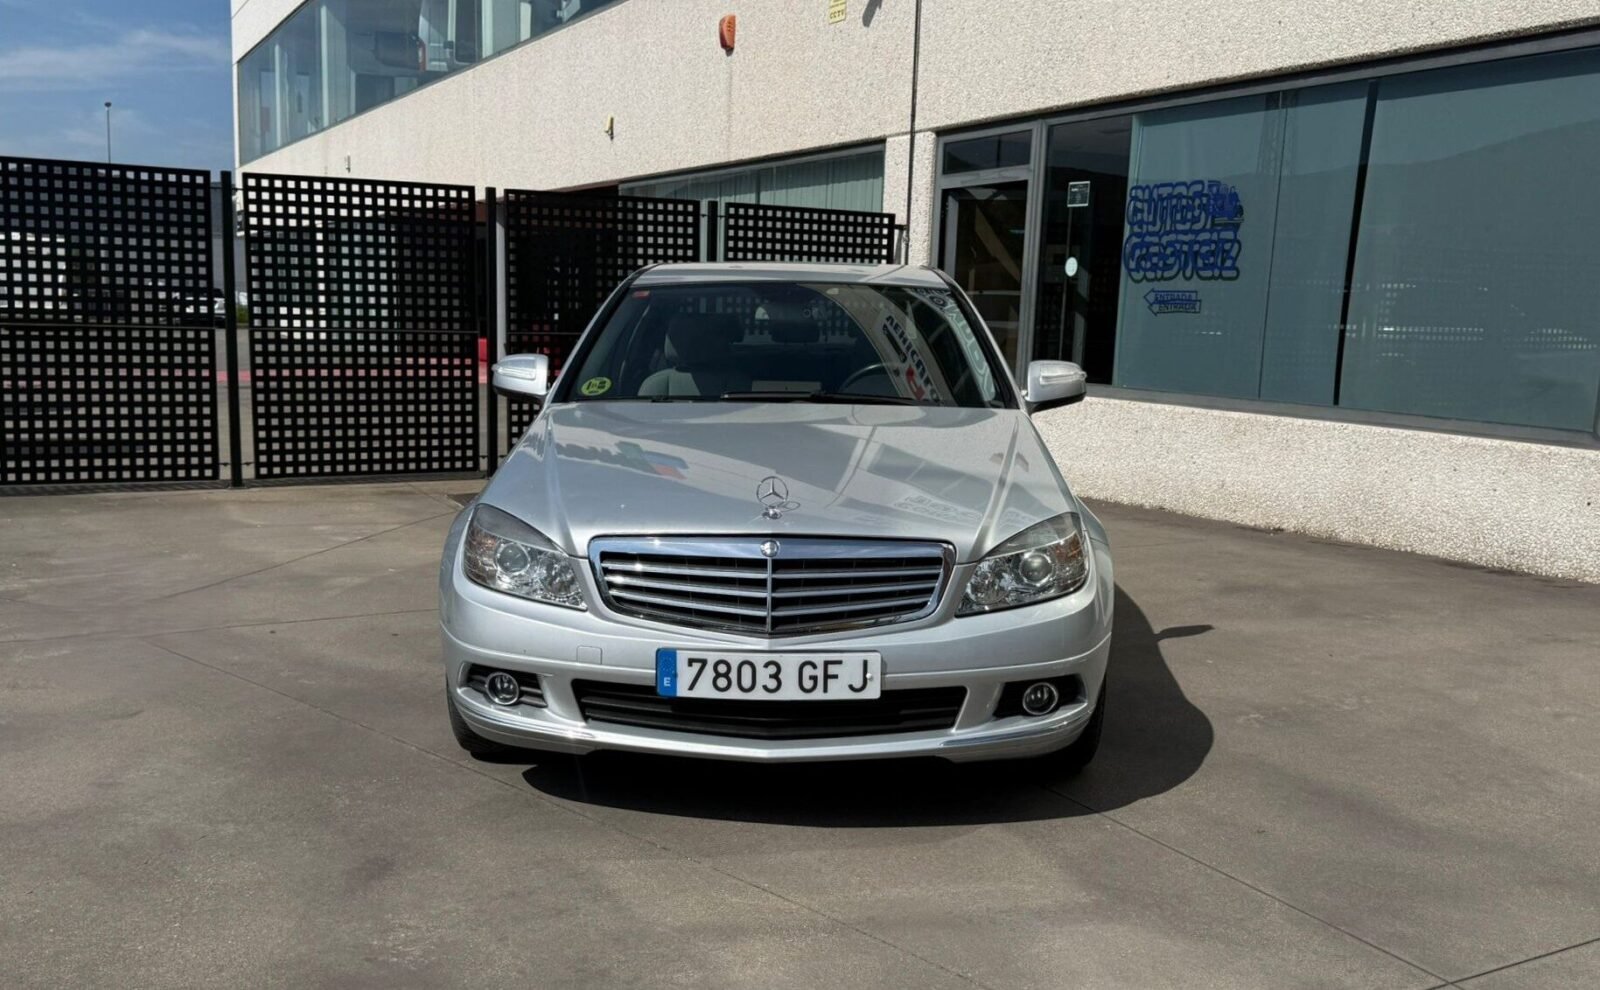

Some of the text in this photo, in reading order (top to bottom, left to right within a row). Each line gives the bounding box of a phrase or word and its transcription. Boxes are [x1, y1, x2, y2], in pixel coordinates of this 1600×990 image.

[829, 9, 845, 20] CCTV
[687, 658, 869, 694] 7803 GFJ
[663, 677, 671, 688] E
